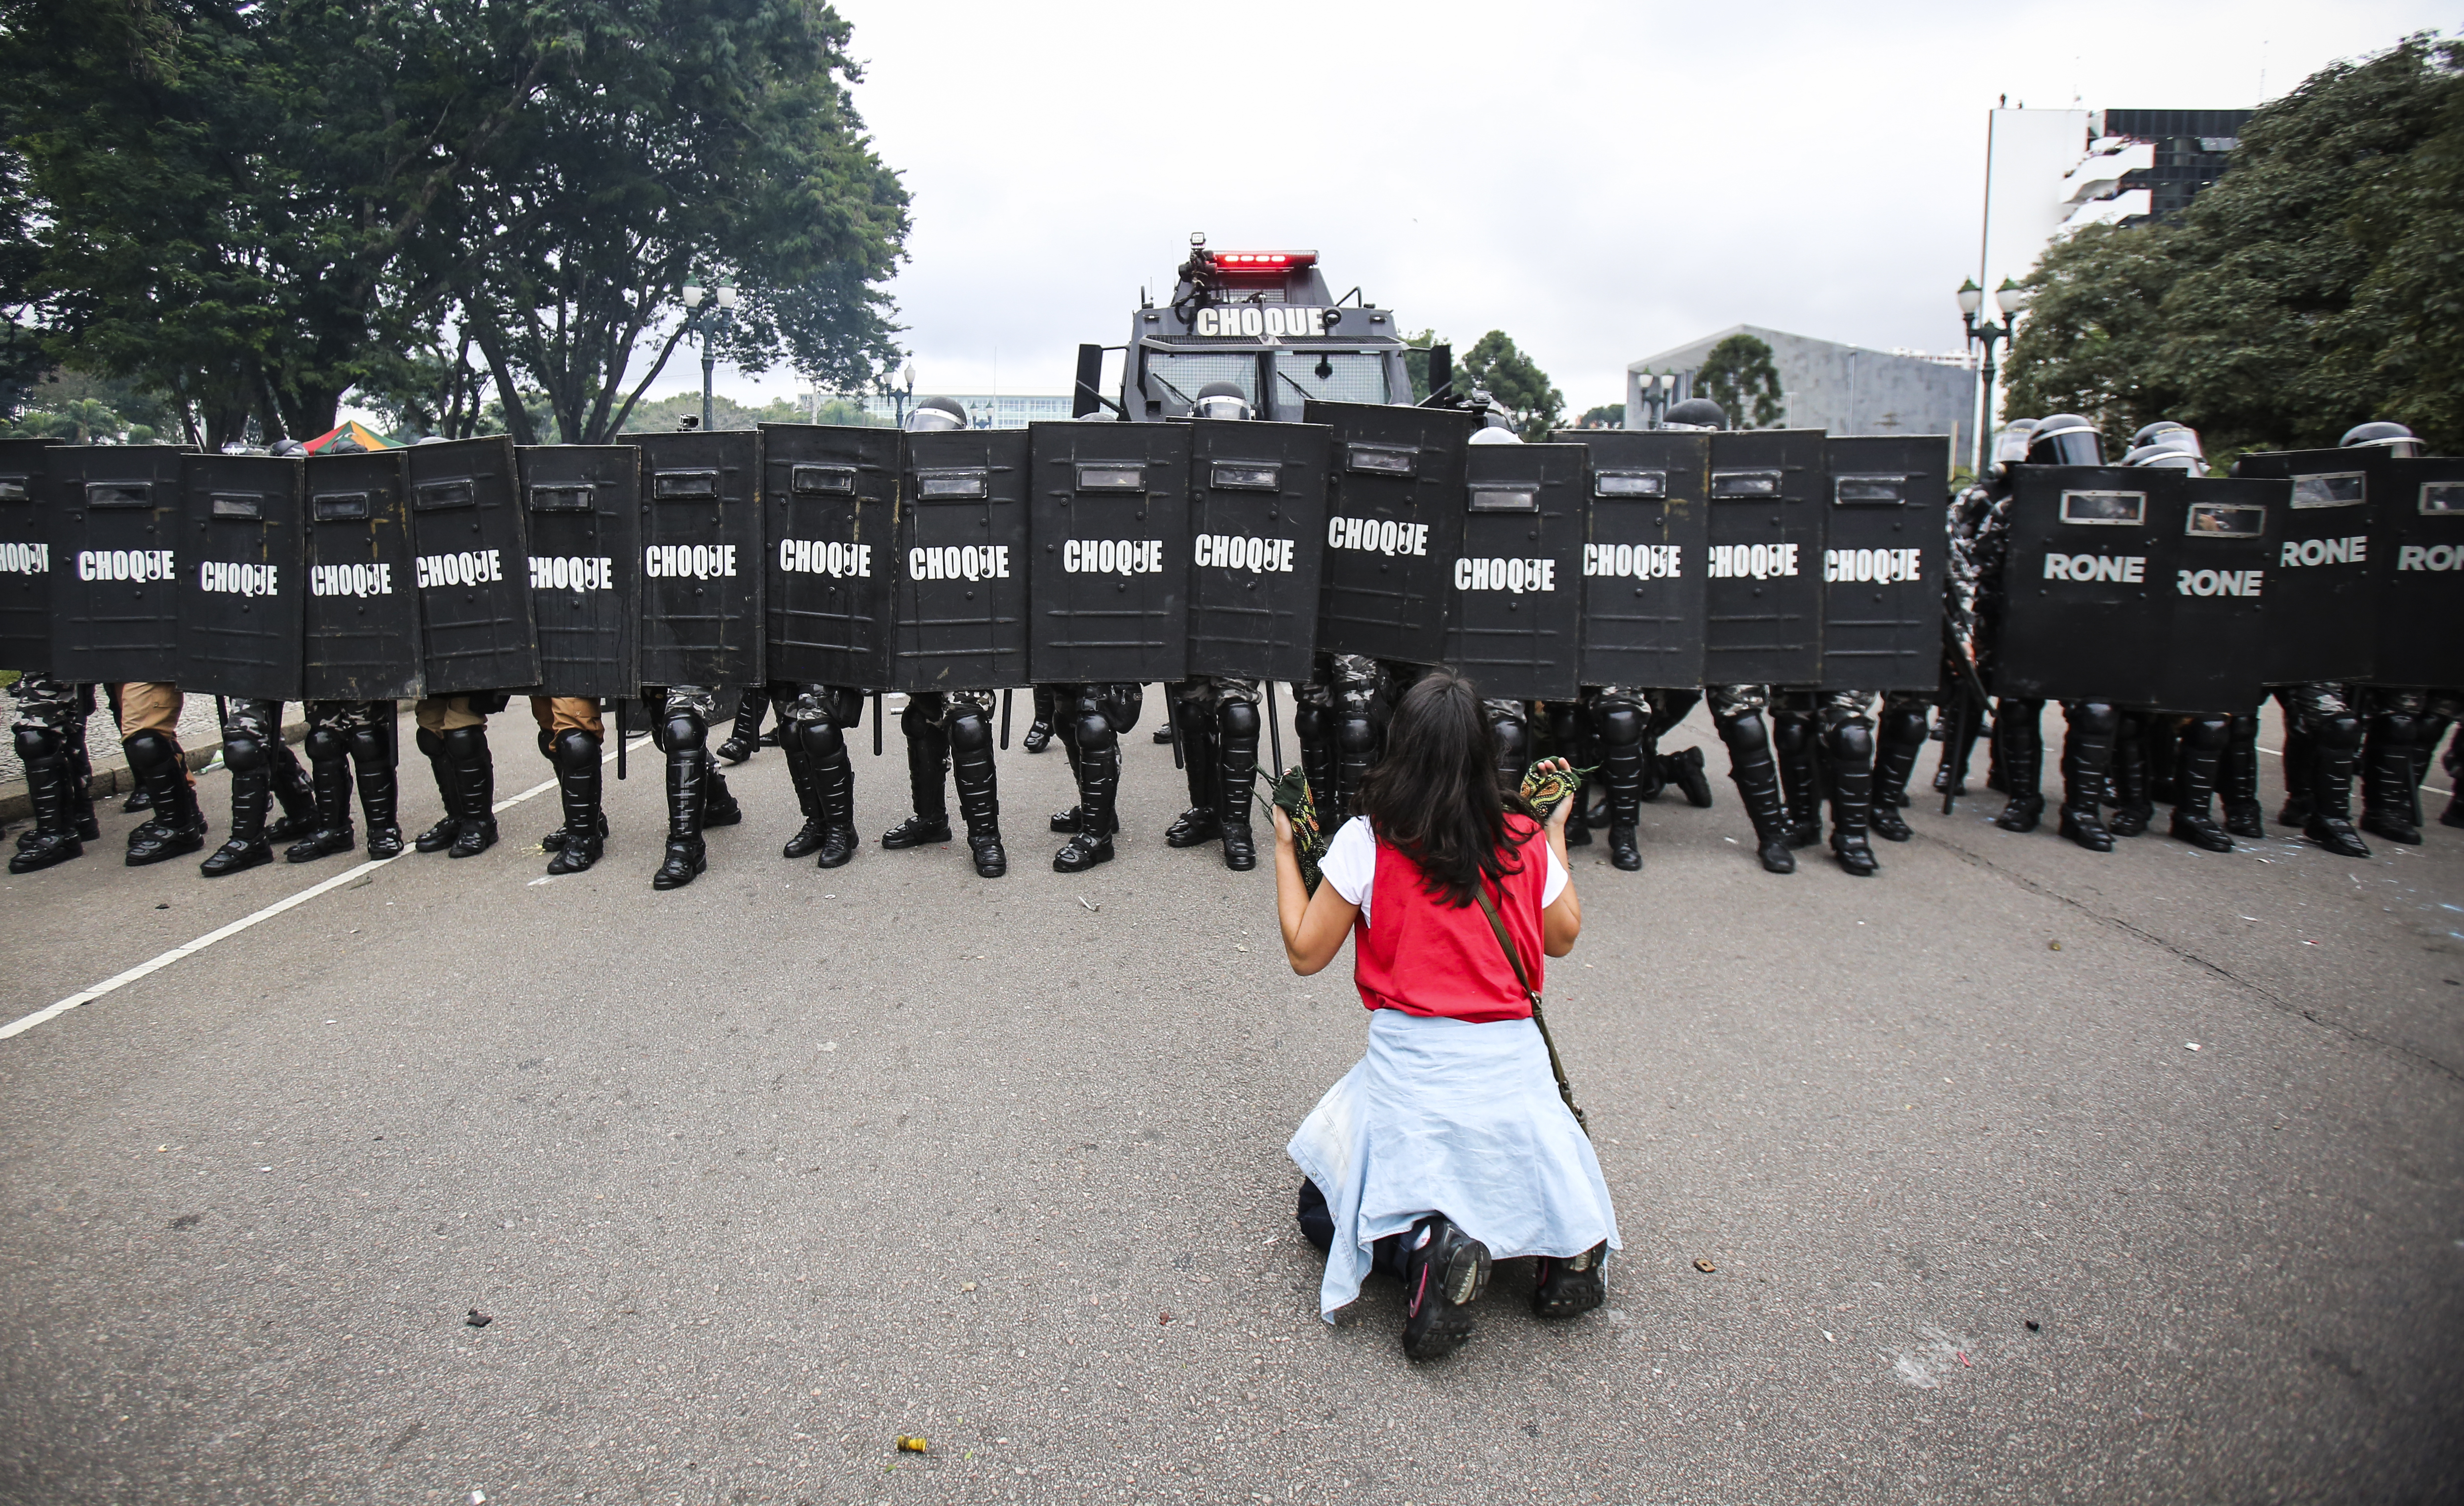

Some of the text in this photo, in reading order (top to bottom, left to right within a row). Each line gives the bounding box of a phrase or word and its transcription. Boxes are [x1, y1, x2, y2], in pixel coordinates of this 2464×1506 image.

[1197, 307, 1326, 337] CHOQUE
[1194, 534, 1295, 574] CHOQUE
[1328, 516, 1429, 556] CHOQUE
[2280, 536, 2367, 567] RONE
[79, 550, 175, 583] CHOQUE
[416, 549, 503, 588] CHOQUE
[646, 544, 736, 580] CHOQUE
[780, 539, 871, 578] CHOQUE
[909, 545, 1009, 581] CHOQUE
[1063, 540, 1163, 576] CHOQUE
[1454, 557, 1555, 594] CHOQUE
[1583, 543, 1681, 580] CHOQUE
[1823, 548, 1921, 584] CHOQUE
[2044, 553, 2146, 583] RONE
[201, 561, 278, 597] CHOQUE
[311, 563, 392, 598] CHOQUE
